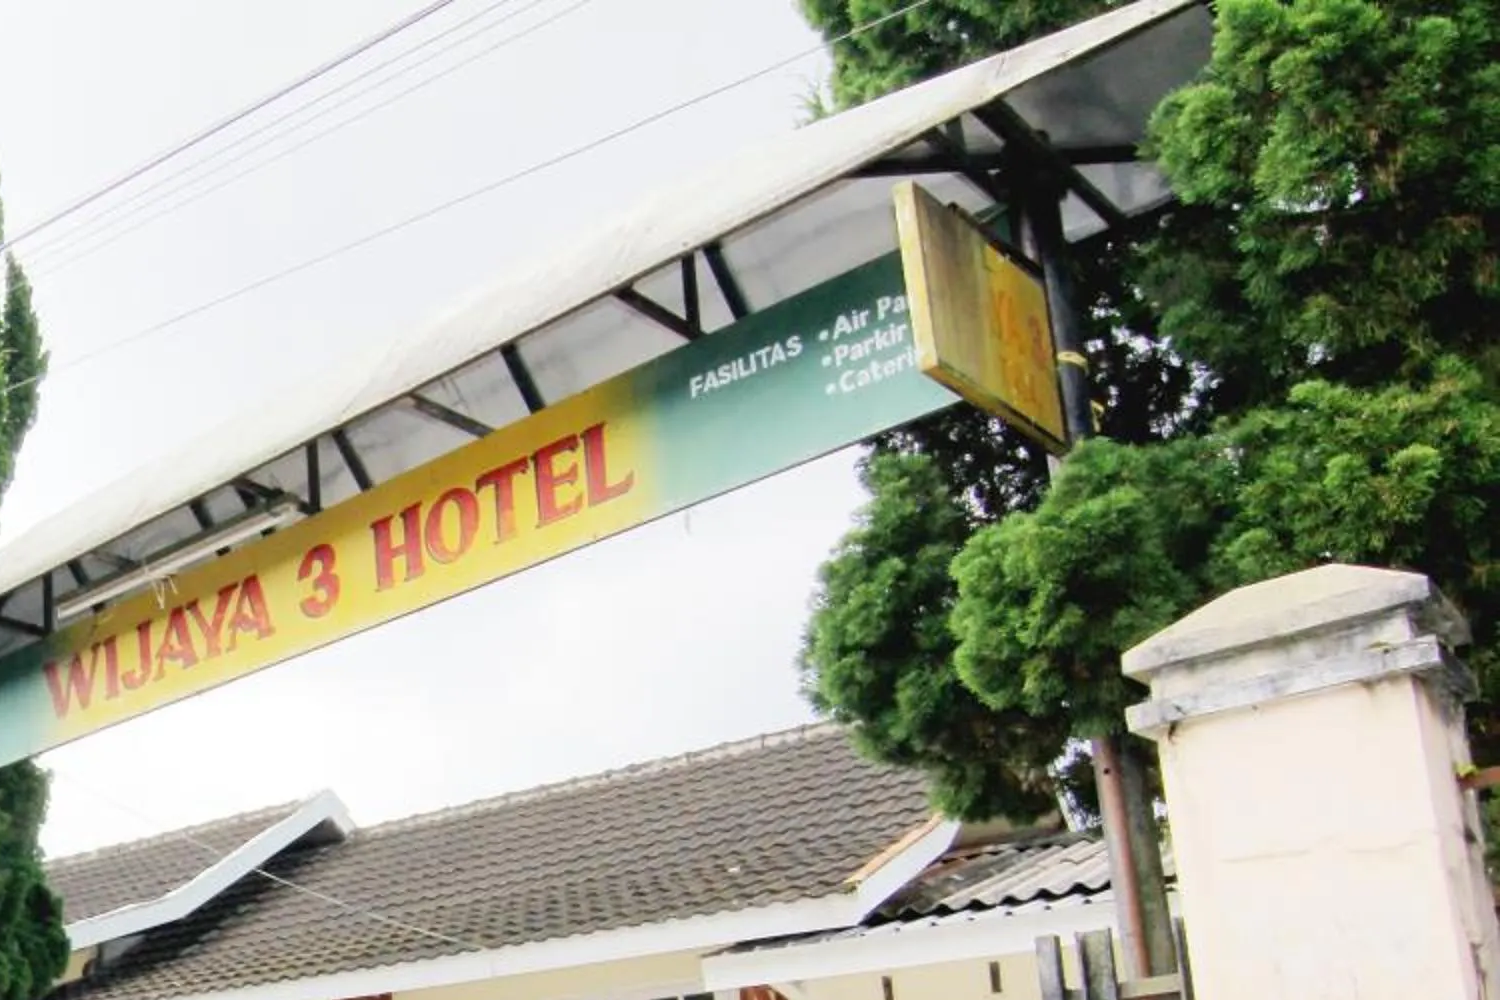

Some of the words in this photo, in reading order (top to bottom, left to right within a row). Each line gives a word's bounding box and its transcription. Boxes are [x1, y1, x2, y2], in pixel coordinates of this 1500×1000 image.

[832, 310, 870, 340] Air
[834, 323, 908, 368] Parkir
[689, 335, 803, 399] FASILITAS
[42, 572, 277, 721] WIJAYA
[296, 543, 341, 619] 3
[370, 421, 634, 592] HOTEL
